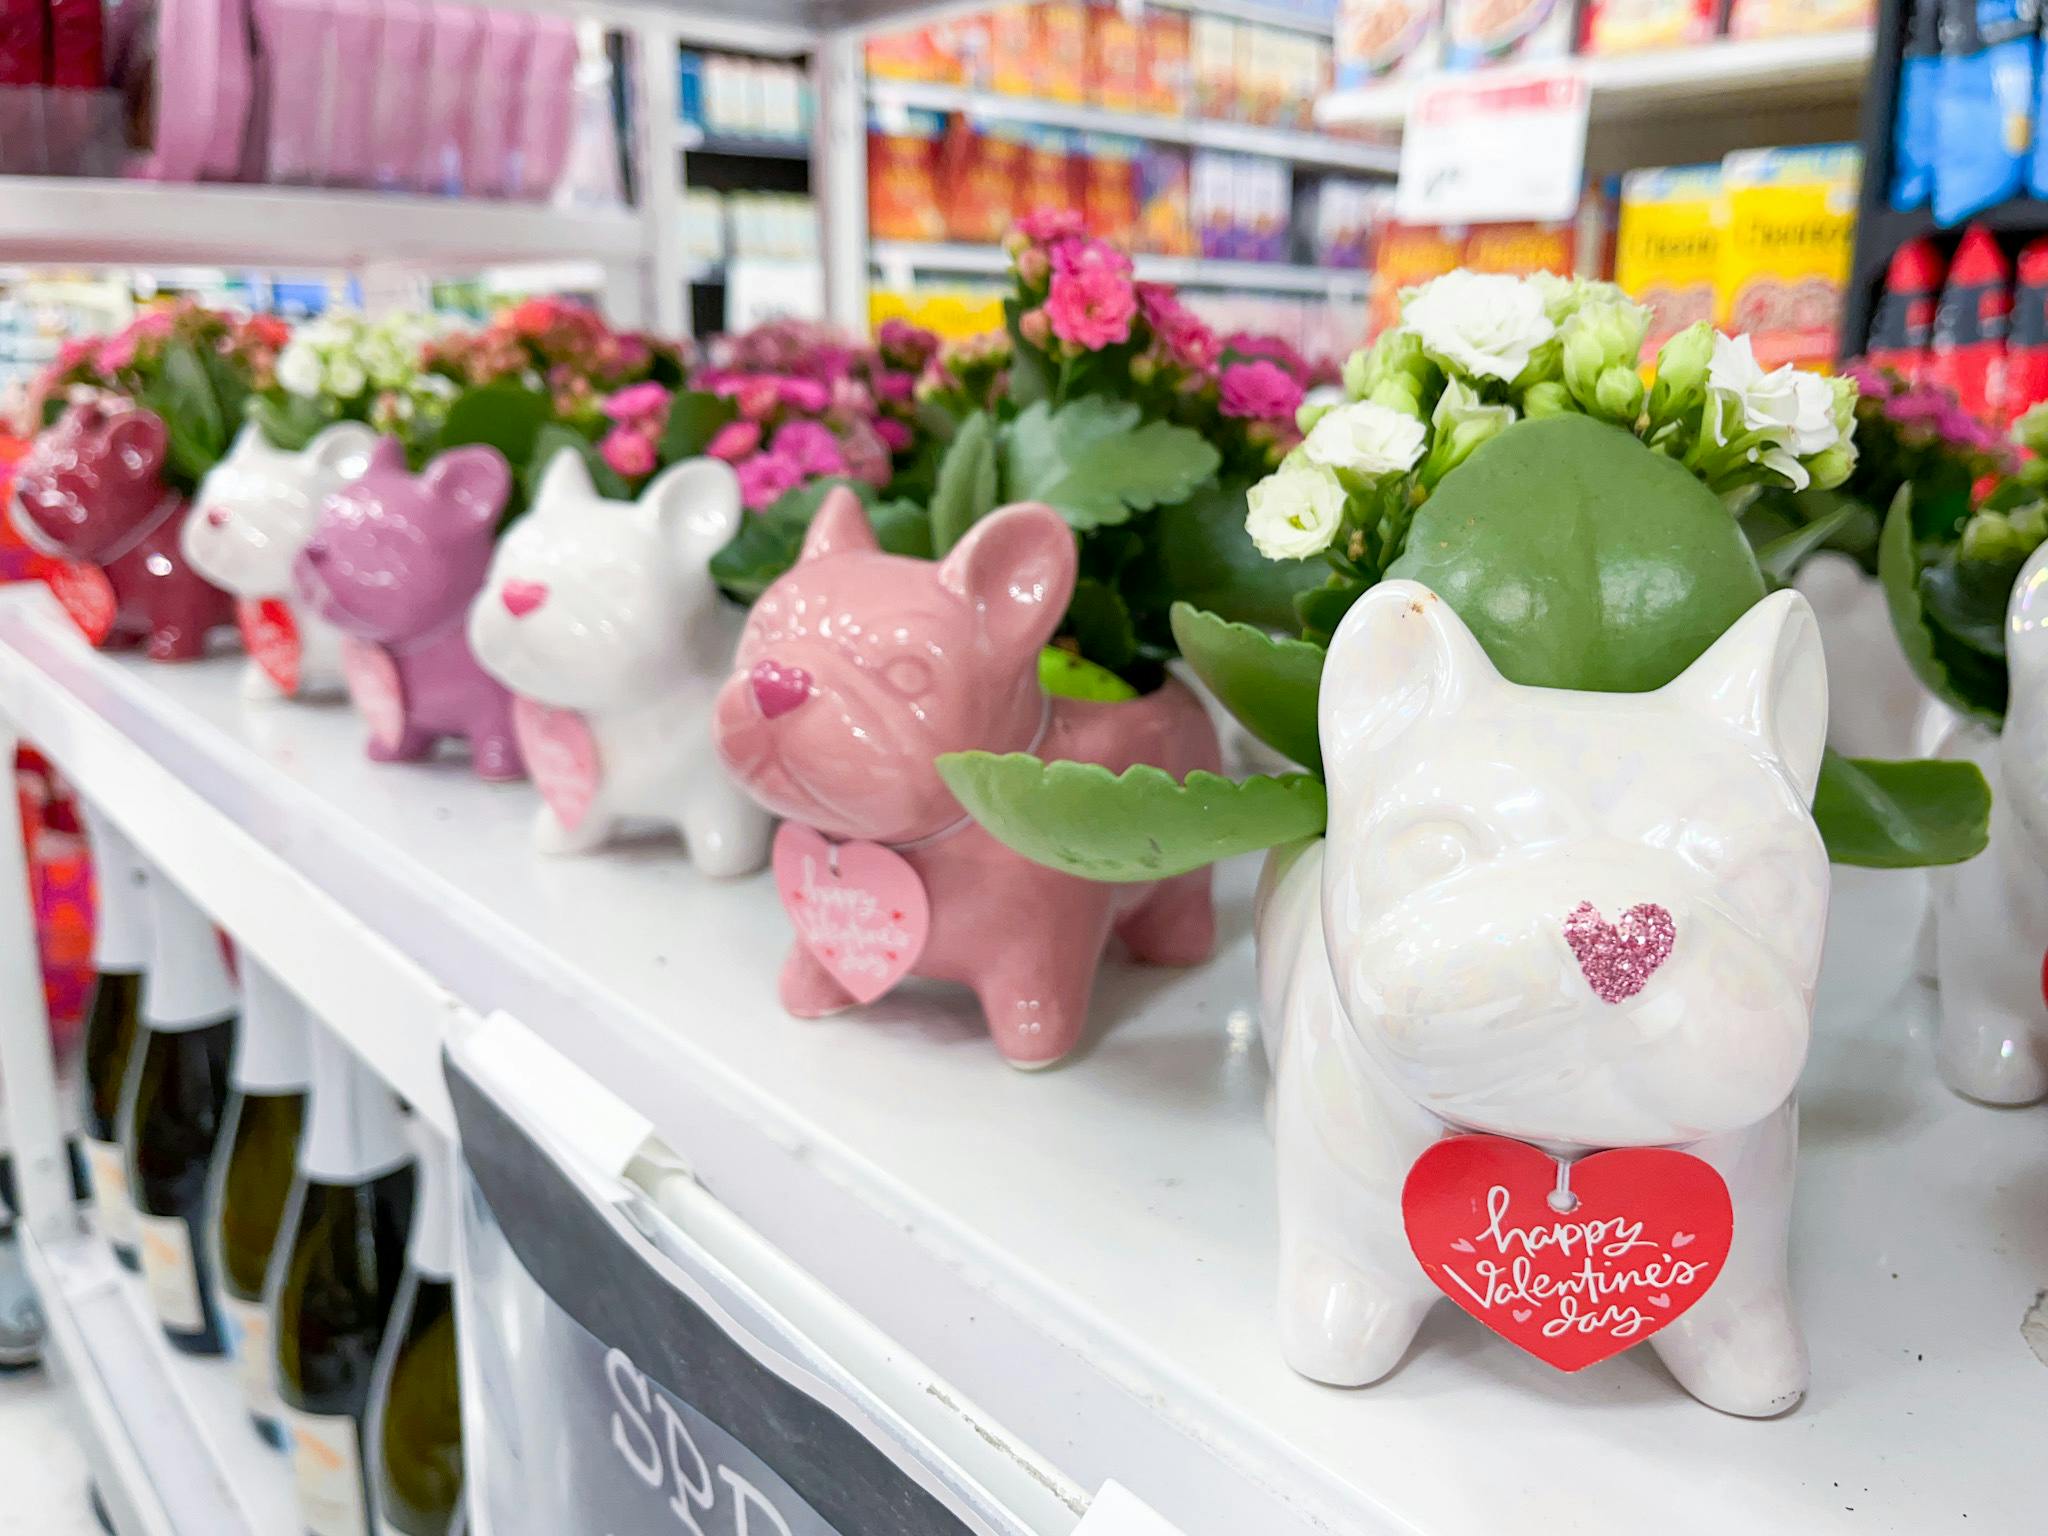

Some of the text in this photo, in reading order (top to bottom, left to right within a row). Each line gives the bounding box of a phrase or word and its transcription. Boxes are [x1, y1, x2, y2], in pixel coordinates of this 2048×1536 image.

[1475, 1185, 1659, 1258] happy
[1441, 1253, 1710, 1309] Valentine's
[1541, 1295, 1656, 1338] day
